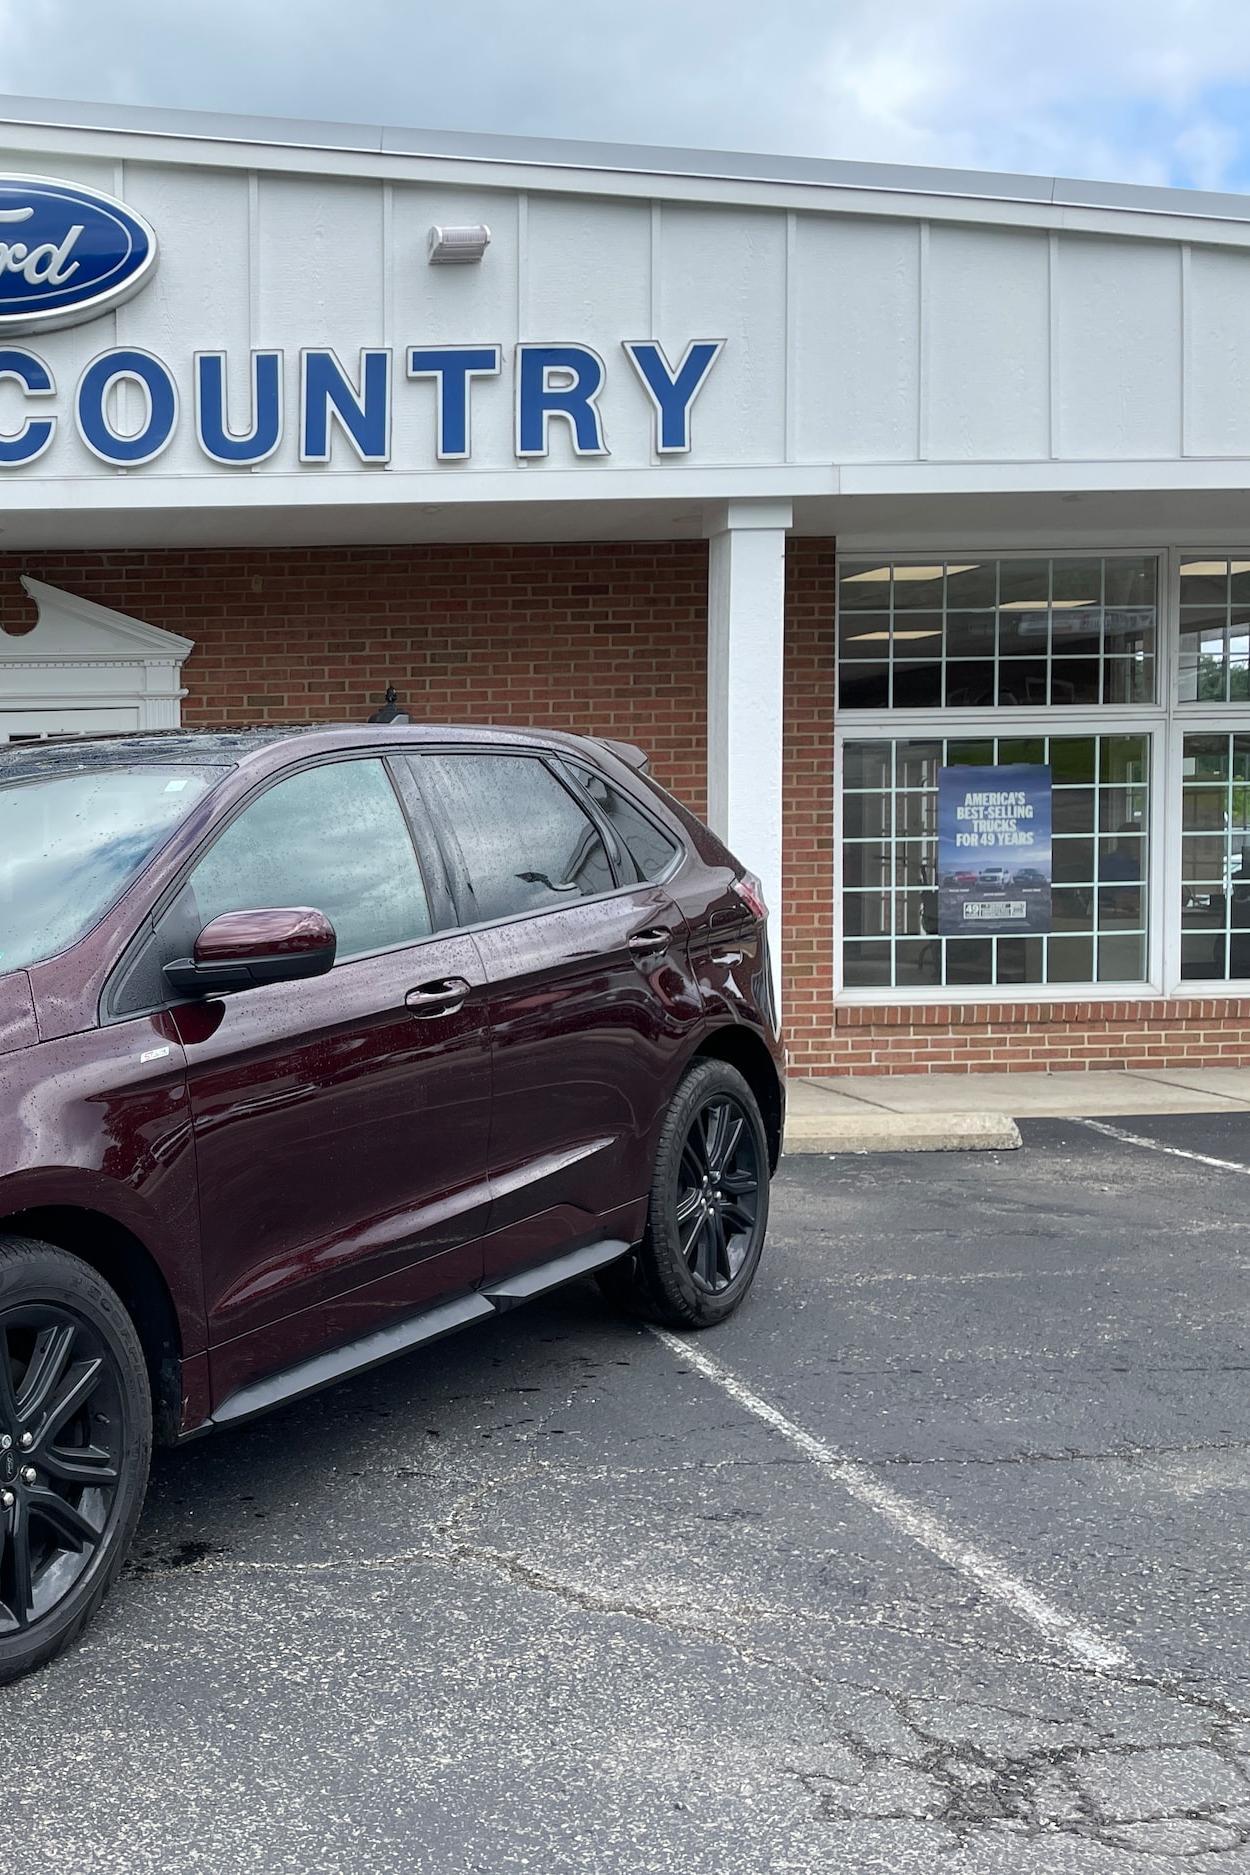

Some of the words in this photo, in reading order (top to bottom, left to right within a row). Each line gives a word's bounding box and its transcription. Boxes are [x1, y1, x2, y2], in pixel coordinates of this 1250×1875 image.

[964, 792, 1026, 806] AMERICA'S
[956, 805, 1034, 820] BEST-SELLING
[972, 819, 1017, 833] TRUCKS
[956, 834, 978, 847] FOR
[980, 833, 996, 847] 49
[998, 832, 1034, 846] YEARS
